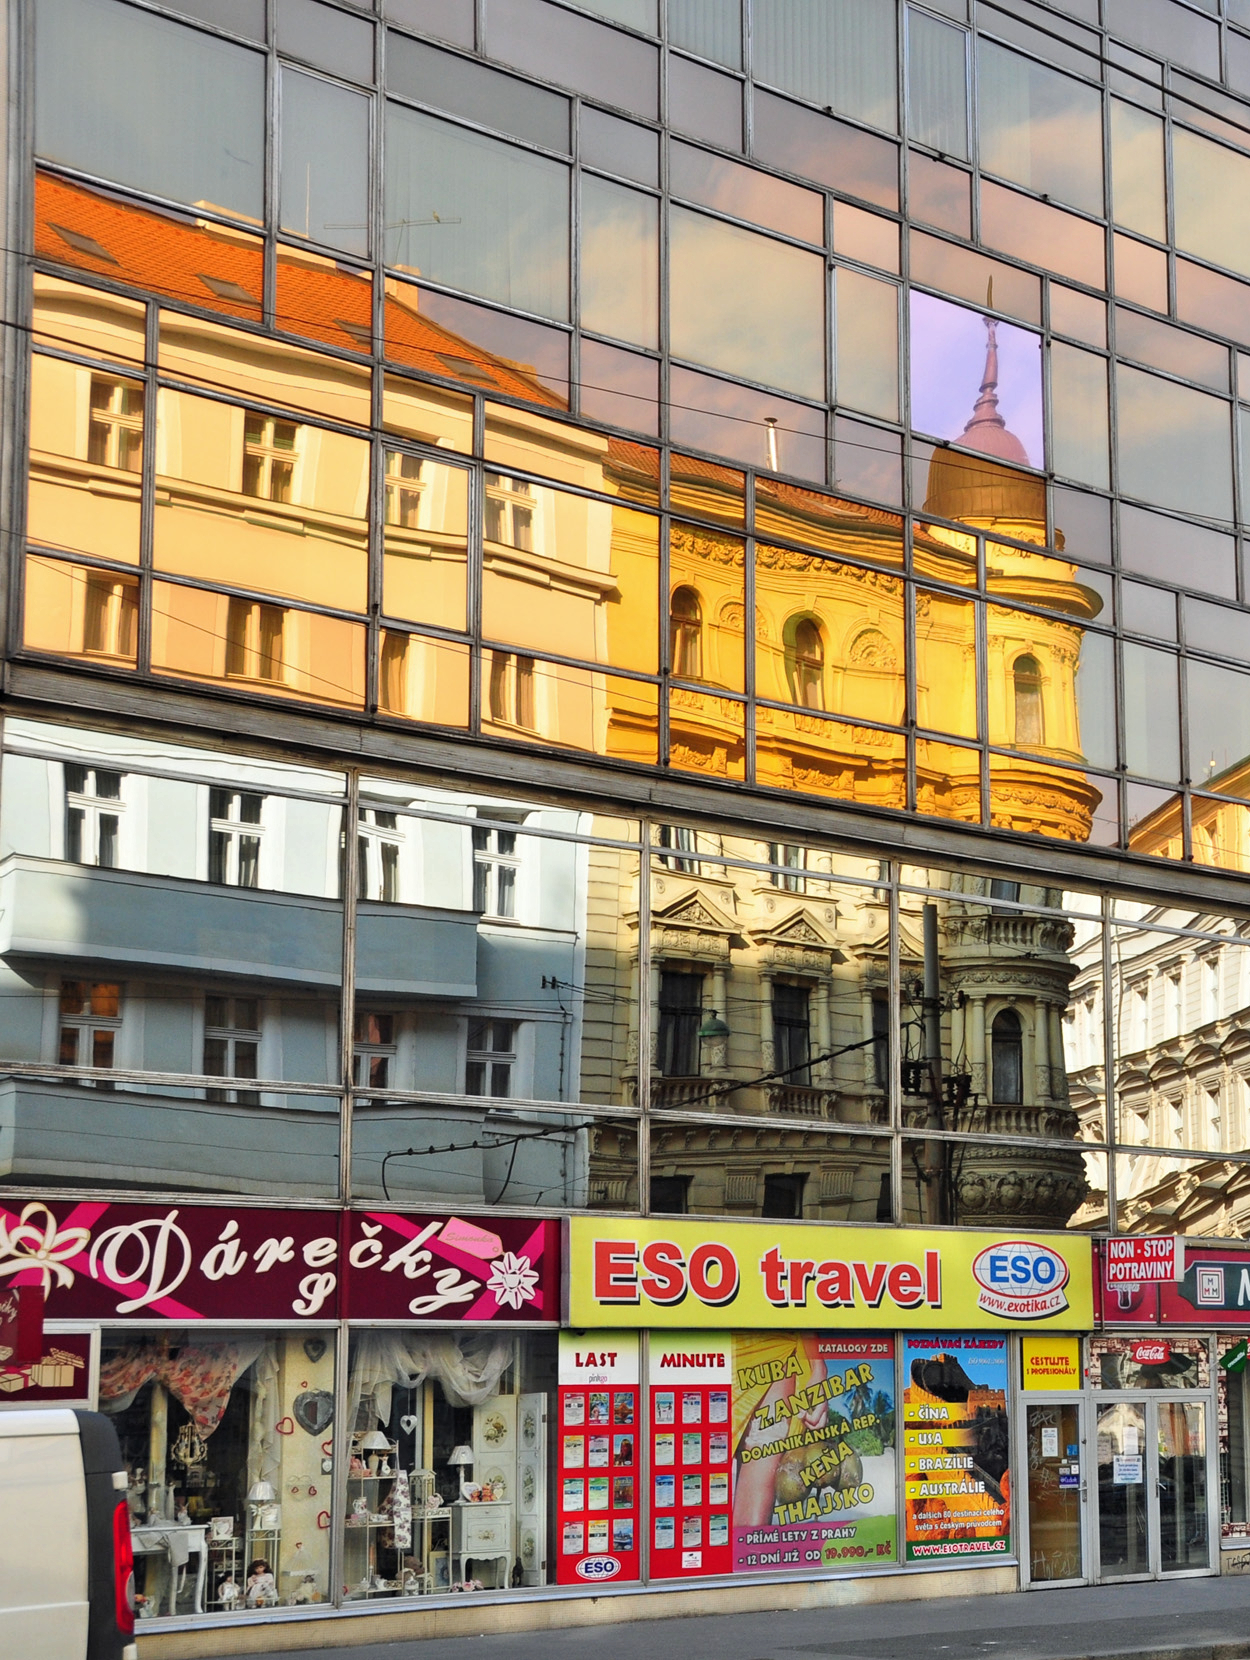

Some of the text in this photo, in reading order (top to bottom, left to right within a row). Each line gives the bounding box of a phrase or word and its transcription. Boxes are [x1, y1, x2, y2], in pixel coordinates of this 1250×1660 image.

[1109, 1241, 1133, 1259] NON
[1143, 1239, 1173, 1258] STOP
[89, 1209, 481, 1315] Dárečky
[990, 1255, 1056, 1284] ESO
[1109, 1260, 1174, 1280] POTRAVINY
[594, 1239, 942, 1309] ESO travel
[979, 1291, 1061, 1314] www.exotika.cz
[818, 1344, 889, 1353] KATALOGY ZDE
[907, 1336, 1005, 1349] POZNÁVACÍ ZÁJEZDY
[575, 1352, 726, 1368] LAST MINUTE
[1030, 1356, 1070, 1366] CESTUJTE
[1136, 1345, 1166, 1361] Coca-Cola
[737, 1355, 804, 1391] KUBA
[1031, 1367, 1077, 1376] PROFESIONÁLY
[755, 1362, 875, 1431] ZANZIBAR
[918, 1404, 949, 1420] ČÍNA
[741, 1413, 880, 1464] DOMINIKÁNSKÁ REP.
[918, 1432, 943, 1445] USA
[799, 1441, 854, 1488] KEŇA
[919, 1454, 974, 1471] BRAZÍLIE
[919, 1478, 986, 1496] AUSTRÁLIE
[774, 1482, 875, 1527] THAJSKO
[915, 1522, 933, 1531] světa
[746, 1527, 857, 1545] PŘÍMÉ LETY Z PRAHY
[913, 1540, 1006, 1556] WWW.ESOTRAVEL.CZ
[747, 1554, 757, 1566] 12
[760, 1551, 780, 1565] DNÍ
[782, 1550, 800, 1563] JIŽ
[805, 1551, 821, 1561] OD
[584, 1560, 615, 1574] ESO
